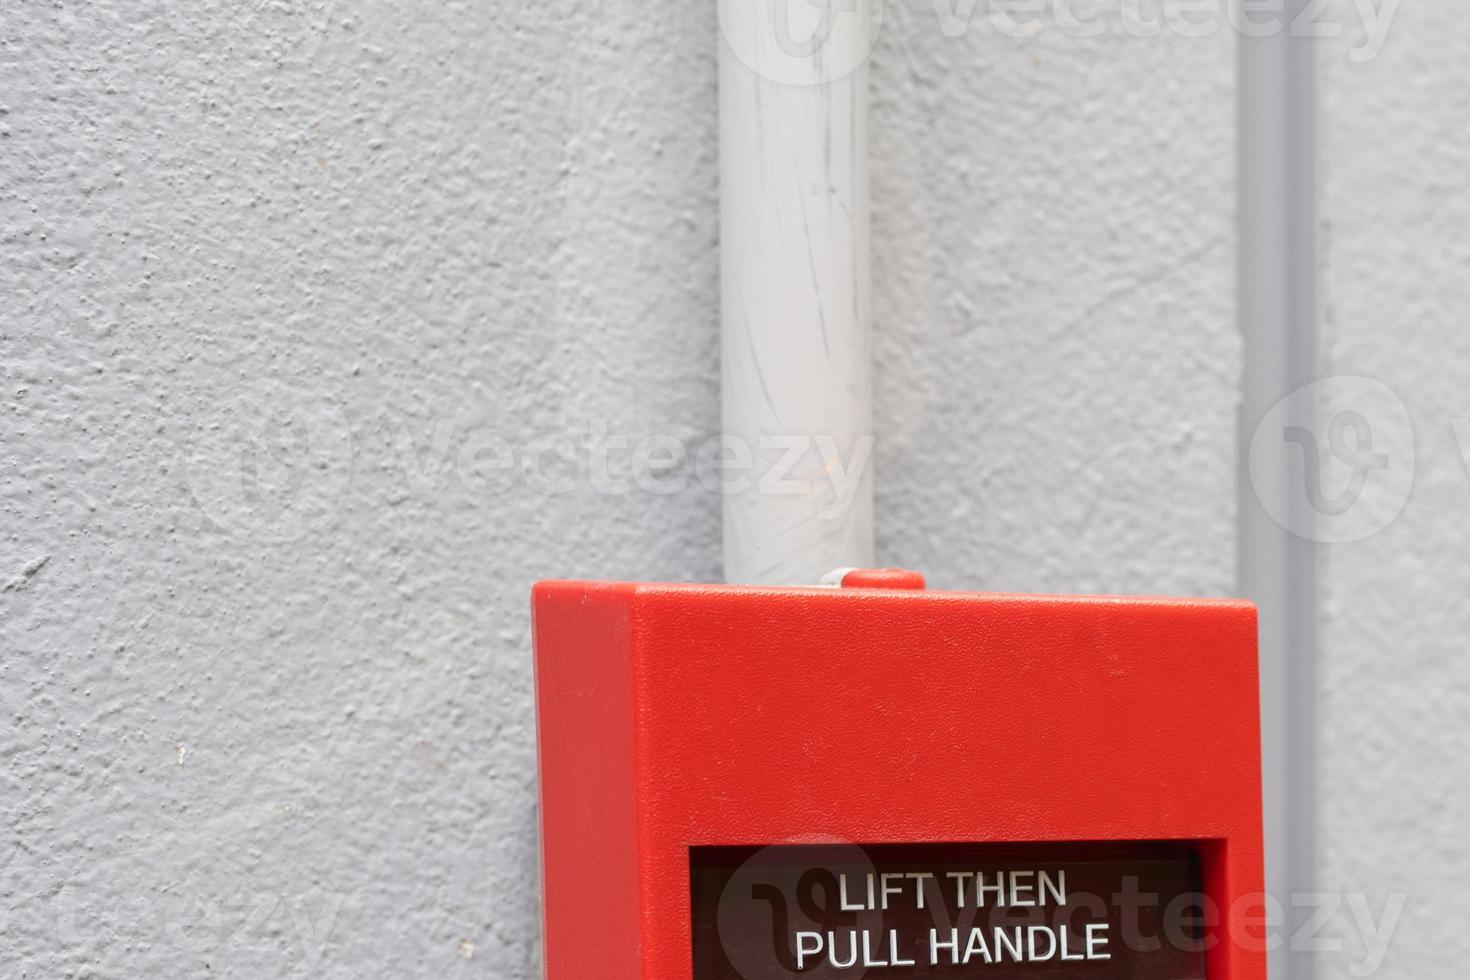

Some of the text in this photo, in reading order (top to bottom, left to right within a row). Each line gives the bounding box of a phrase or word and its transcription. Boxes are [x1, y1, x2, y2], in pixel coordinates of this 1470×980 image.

[839, 869, 1067, 911] LIFT THEN
[796, 923, 1111, 970] PULL HANDLE
